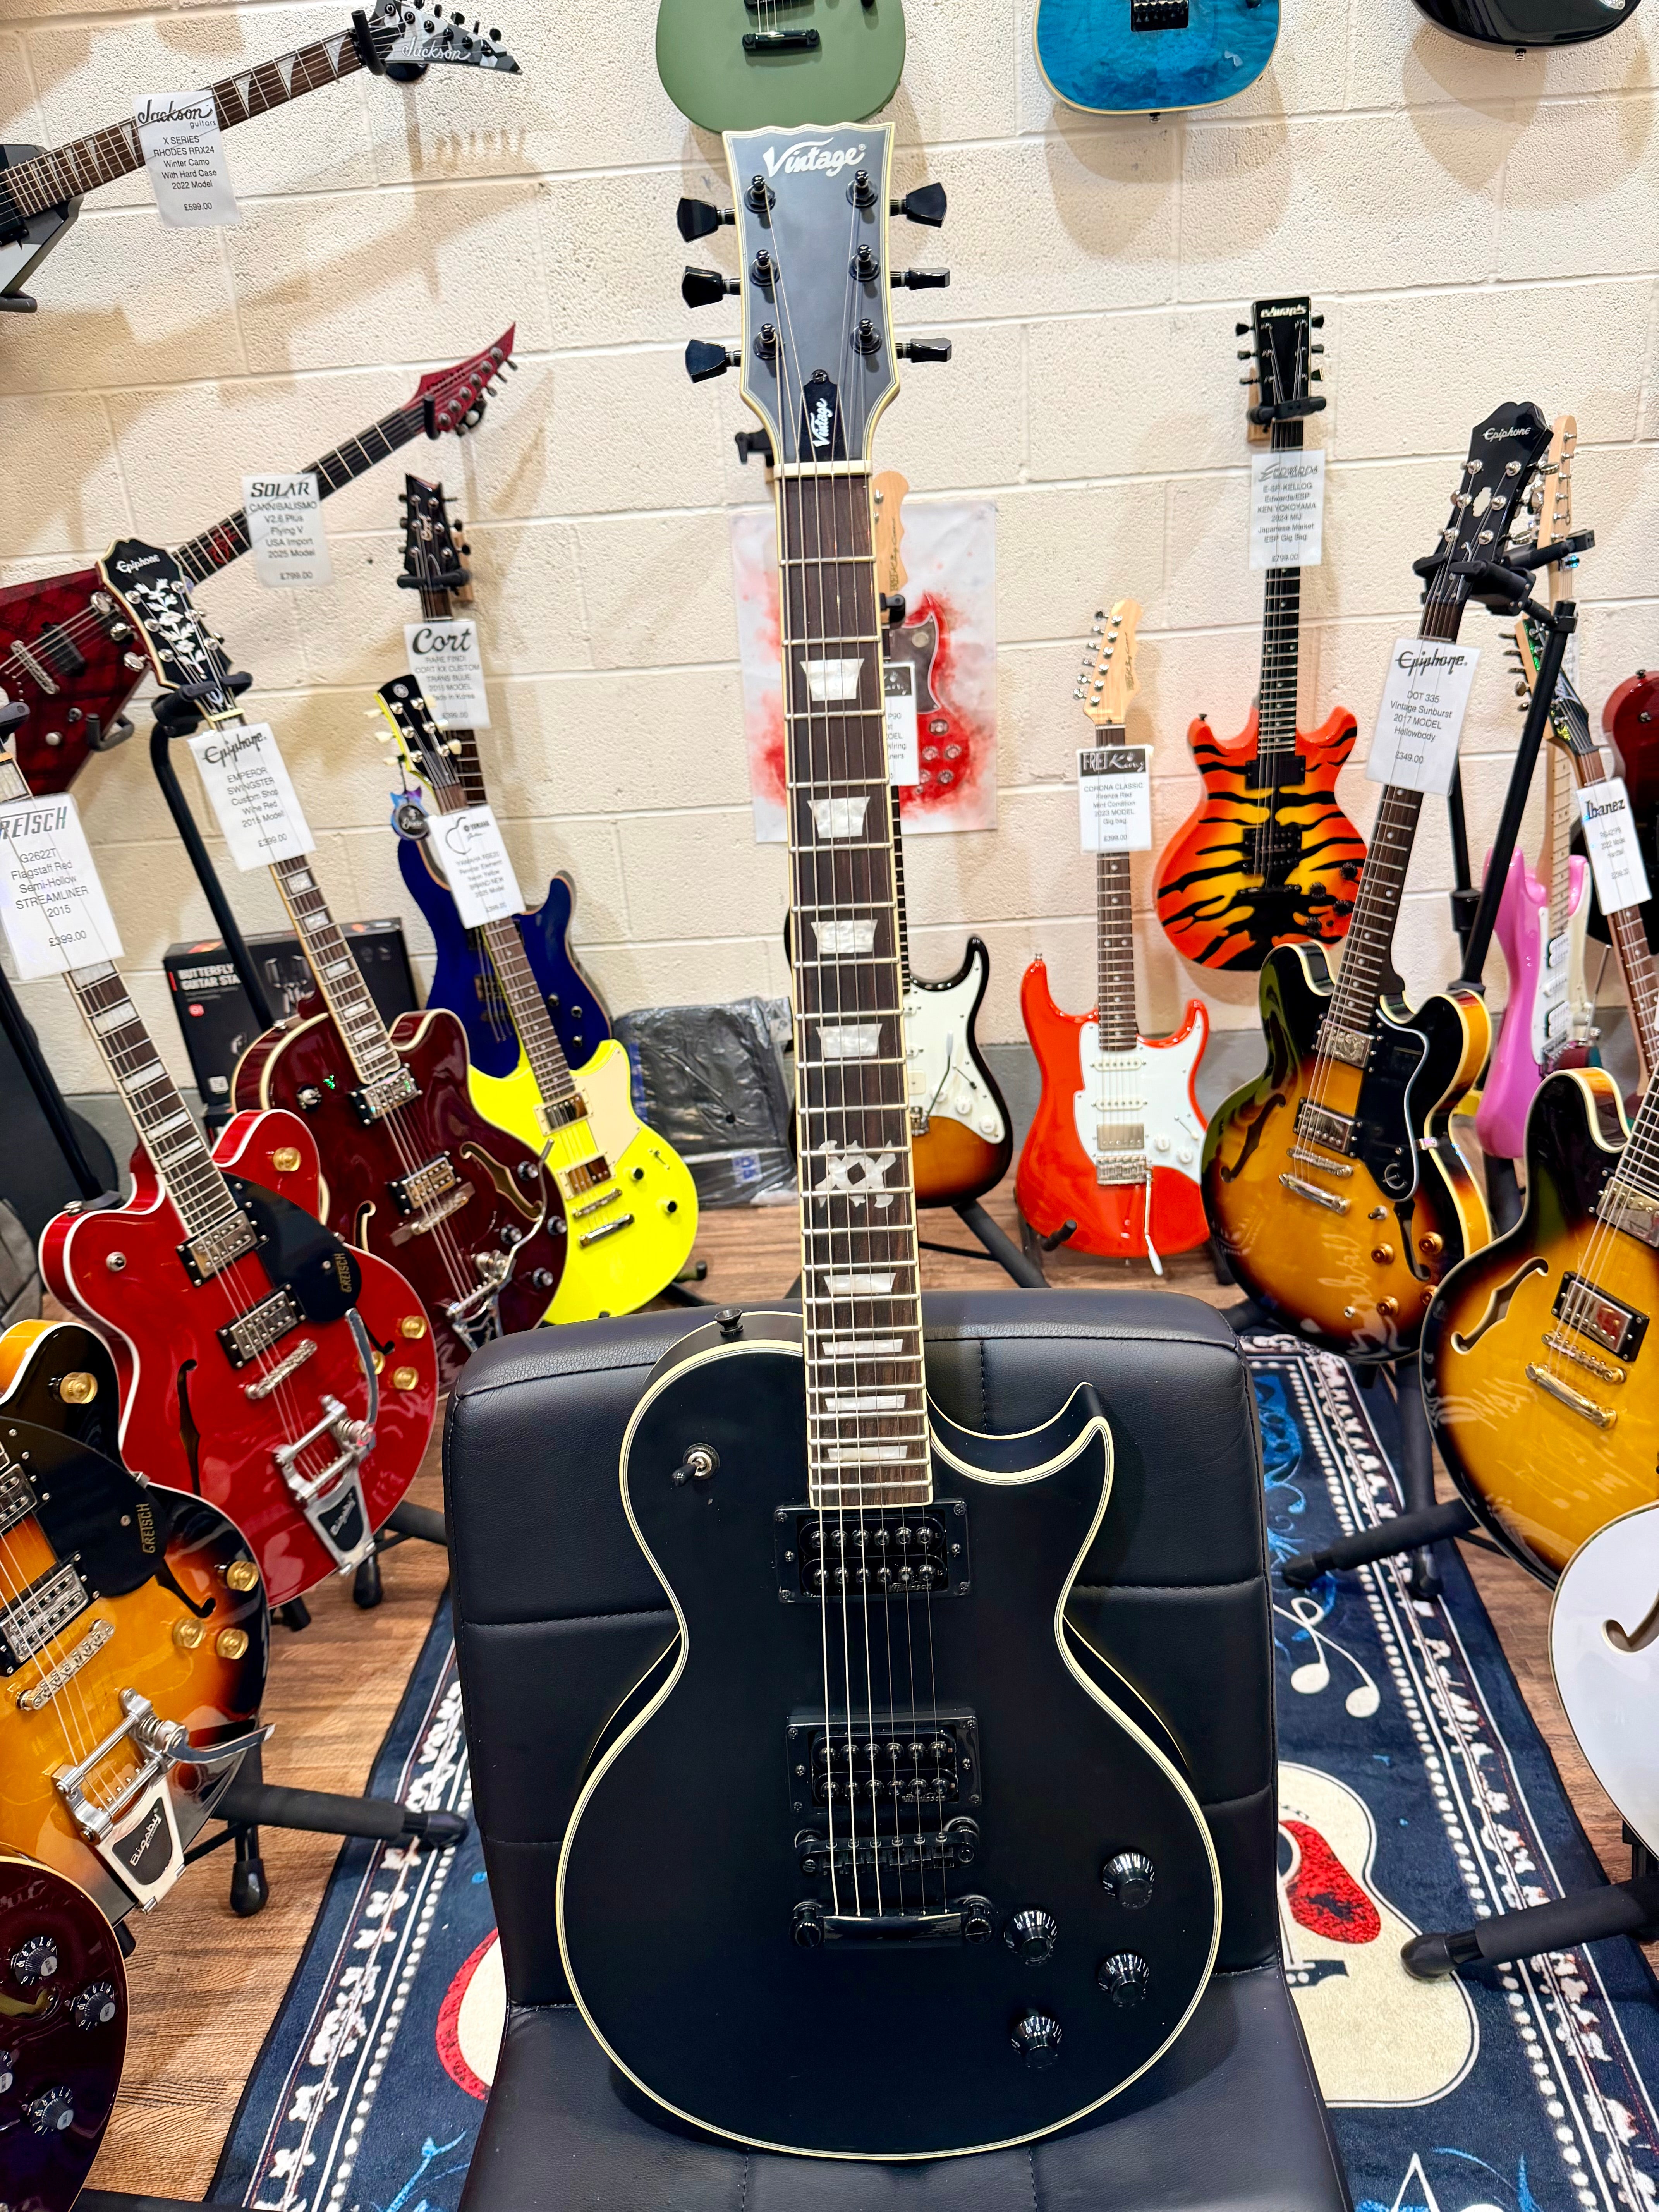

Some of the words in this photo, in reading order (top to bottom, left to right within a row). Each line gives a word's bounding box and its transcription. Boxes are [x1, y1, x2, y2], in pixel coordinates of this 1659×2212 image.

[402, 36, 471, 60] Jackson
[138, 99, 213, 124] Jackson
[190, 120, 216, 128] guitars
[163, 137, 170, 145] X
[171, 136, 199, 144] SERIES
[153, 148, 187, 157] RHODES
[189, 146, 214, 155] RRX24
[163, 160, 186, 168] Winter
[191, 180, 213, 188] Model
[184, 203, 212, 211] £599.00
[810, 398, 833, 447] Vintage
[1482, 426, 1532, 442] Epiphone
[251, 482, 309, 497] SOLAR
[1257, 505, 1273, 513] KEN
[1275, 503, 1316, 511] YOKOYAMA
[271, 527, 295, 536] Flying
[1281, 534, 1292, 542] Gig
[265, 539, 285, 547] USA
[116, 554, 160, 573] Epiphone
[412, 629, 472, 655] Cort
[1396, 649, 1465, 676] Epiphone
[1407, 691, 1424, 701] DOT
[1425, 693, 1440, 703] 335
[1390, 701, 1417, 713] Vintage
[1418, 706, 1453, 718] Sunburst
[1393, 714, 1412, 724] 2017
[1413, 716, 1441, 730] MODEL
[1394, 726, 1436, 742] Hollowbody
[202, 733, 264, 767] Epiphone
[1395, 751, 1424, 764] £349.00
[1083, 752, 1108, 772] FRET
[227, 767, 267, 783] EMPEROR
[227, 777, 275, 795] SWINGSTER
[1084, 784, 1113, 792] CORONA
[1115, 782, 1144, 790] CLASSIC
[232, 793, 261, 806] Custom
[263, 789, 279, 799] Shop
[263, 800, 278, 810] Red
[1585, 799, 1625, 820] Ibanez
[0, 806, 67, 840] RETSCH
[20, 848, 57, 863] G2622T
[11, 865, 54, 880] Flagstaff
[55, 860, 72, 873] Red
[19, 875, 77, 893] Semi-Hollow
[15, 886, 89, 909] STREAMLINER
[47, 904, 71, 917] 2015
[48, 930, 86, 947] £399.00
[178, 963, 234, 980] BUTTERFLY
[181, 976, 219, 990] GUITAR
[219, 974, 241, 986] STA
[333, 1253, 352, 1293] GRETSCH
[136, 1503, 155, 1553] GRETSCH
[130, 1814, 162, 1866] Bigsby
